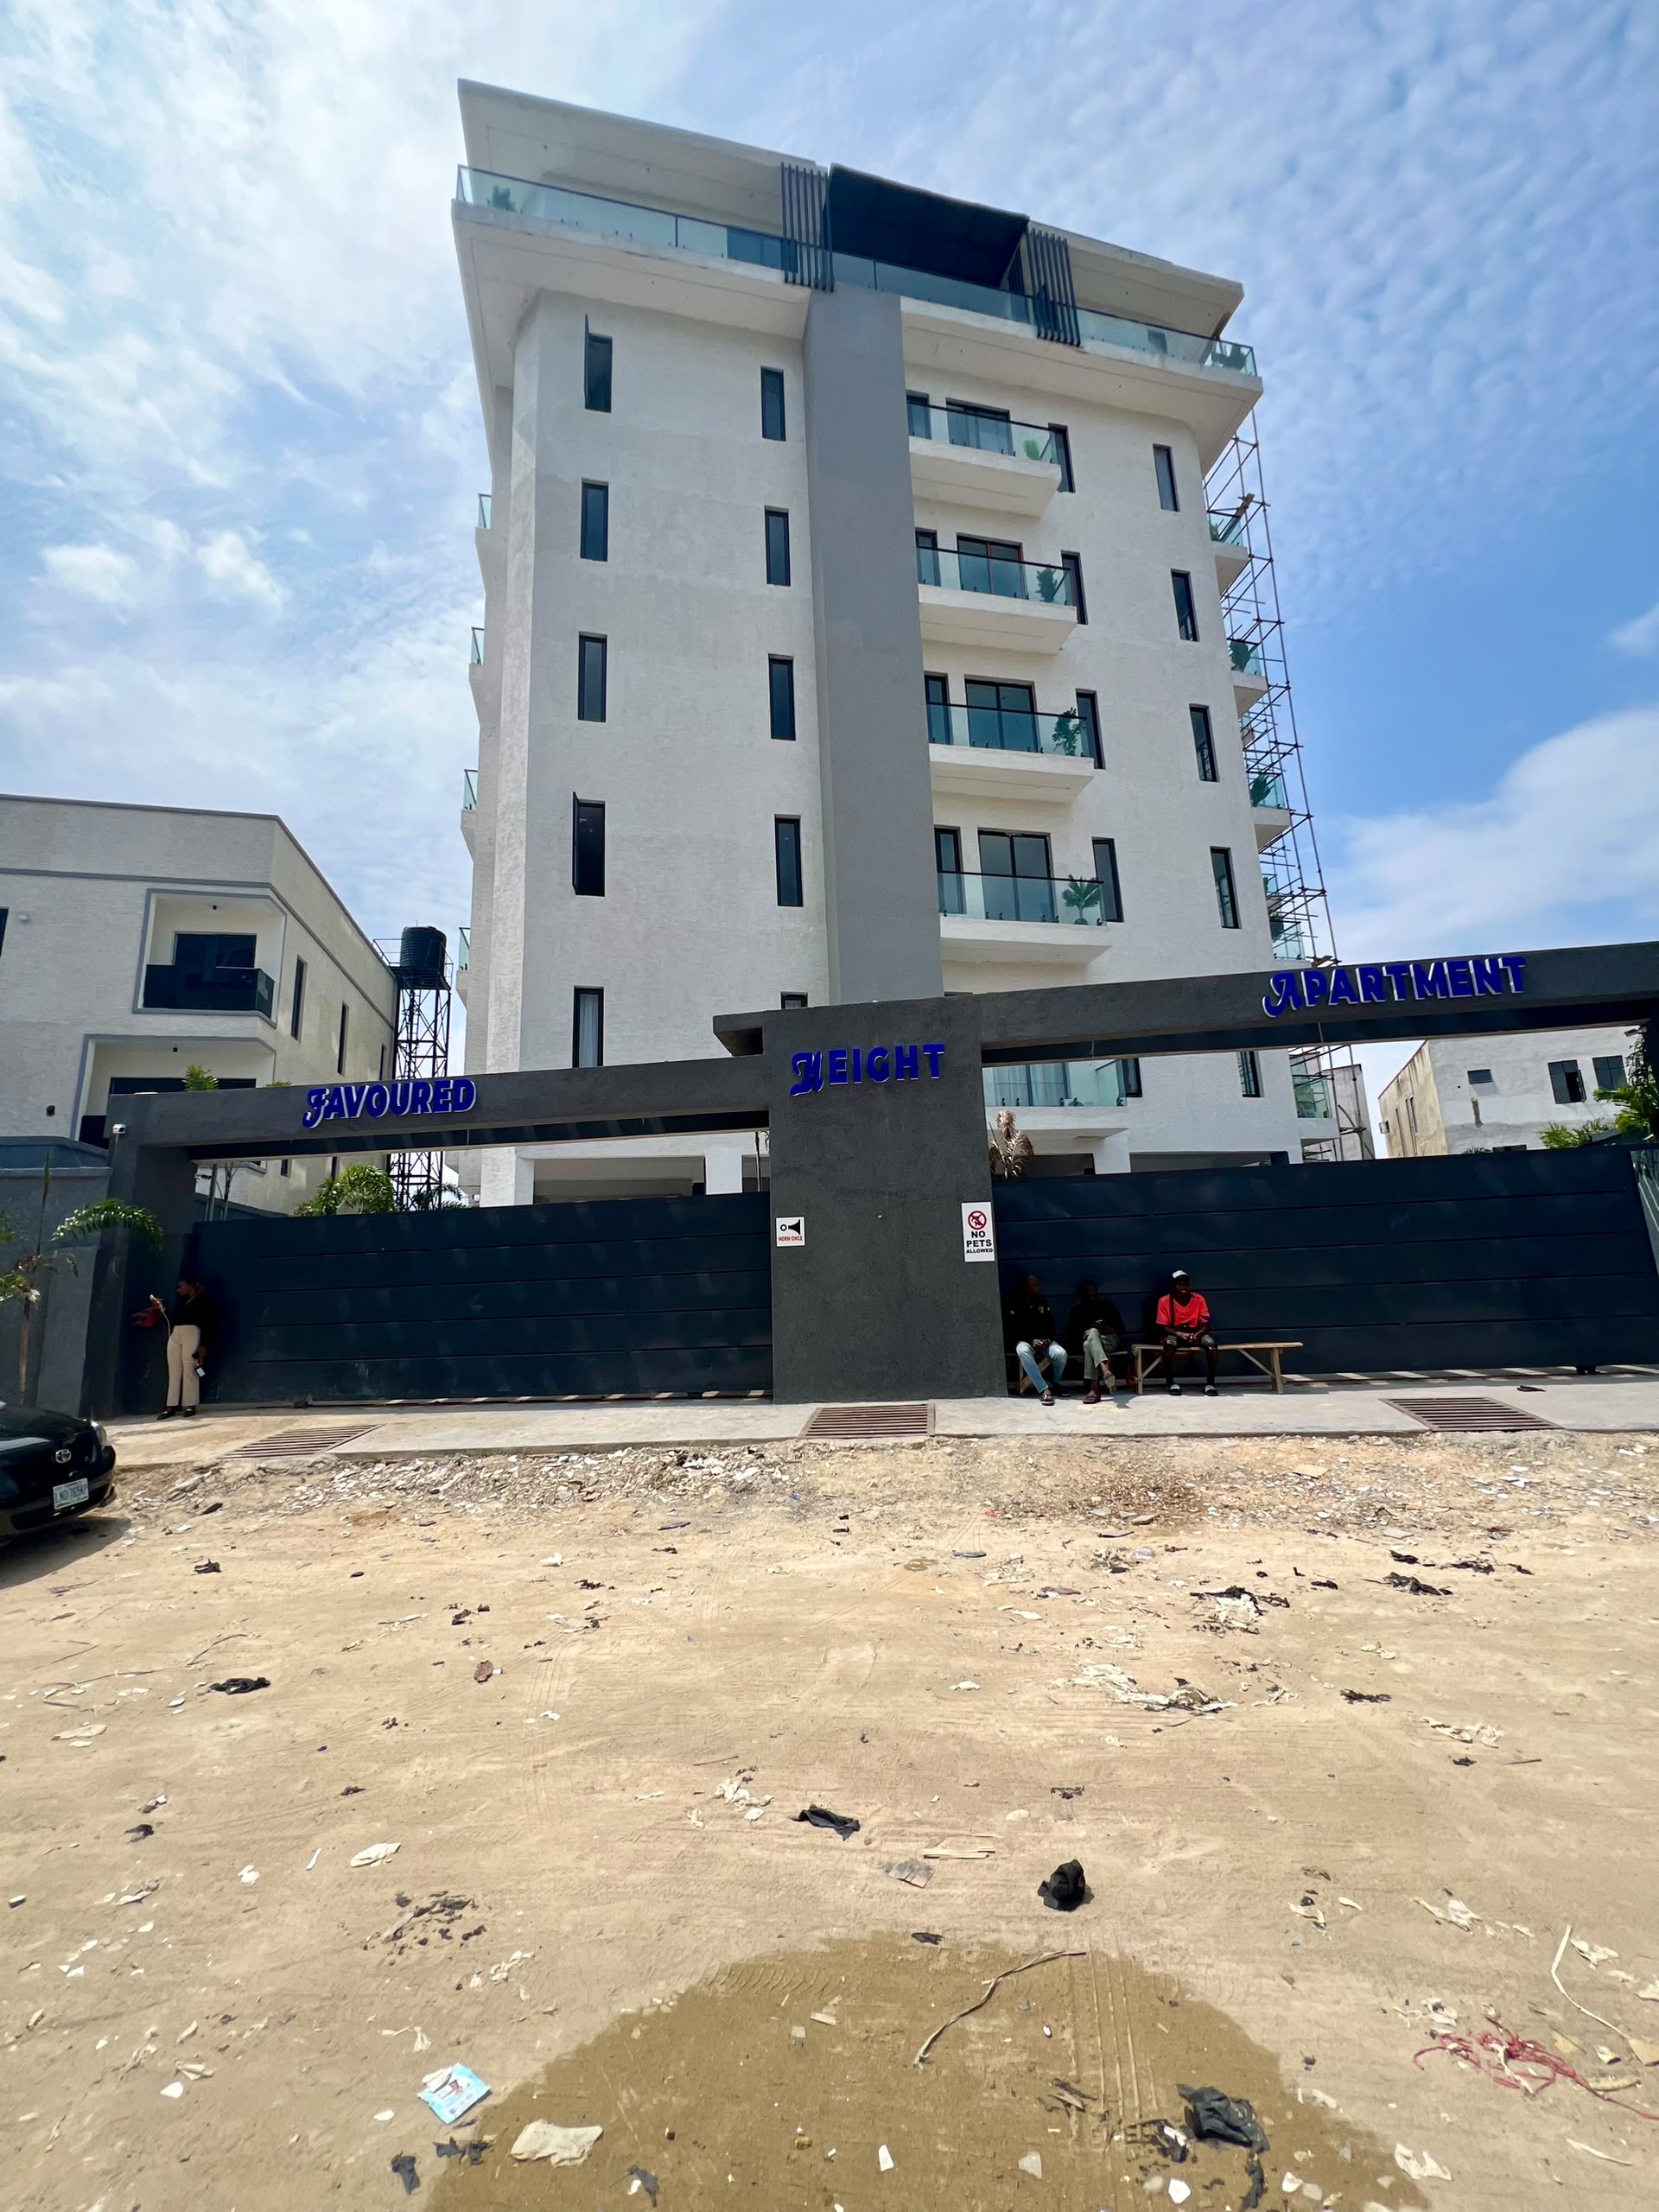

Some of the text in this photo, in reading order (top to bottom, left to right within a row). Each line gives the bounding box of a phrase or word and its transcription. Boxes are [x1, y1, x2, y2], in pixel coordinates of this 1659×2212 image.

[302, 955, 1527, 1128] FAVOURED HEIGHT APARTMENT
[966, 1239, 992, 1248] PETS
